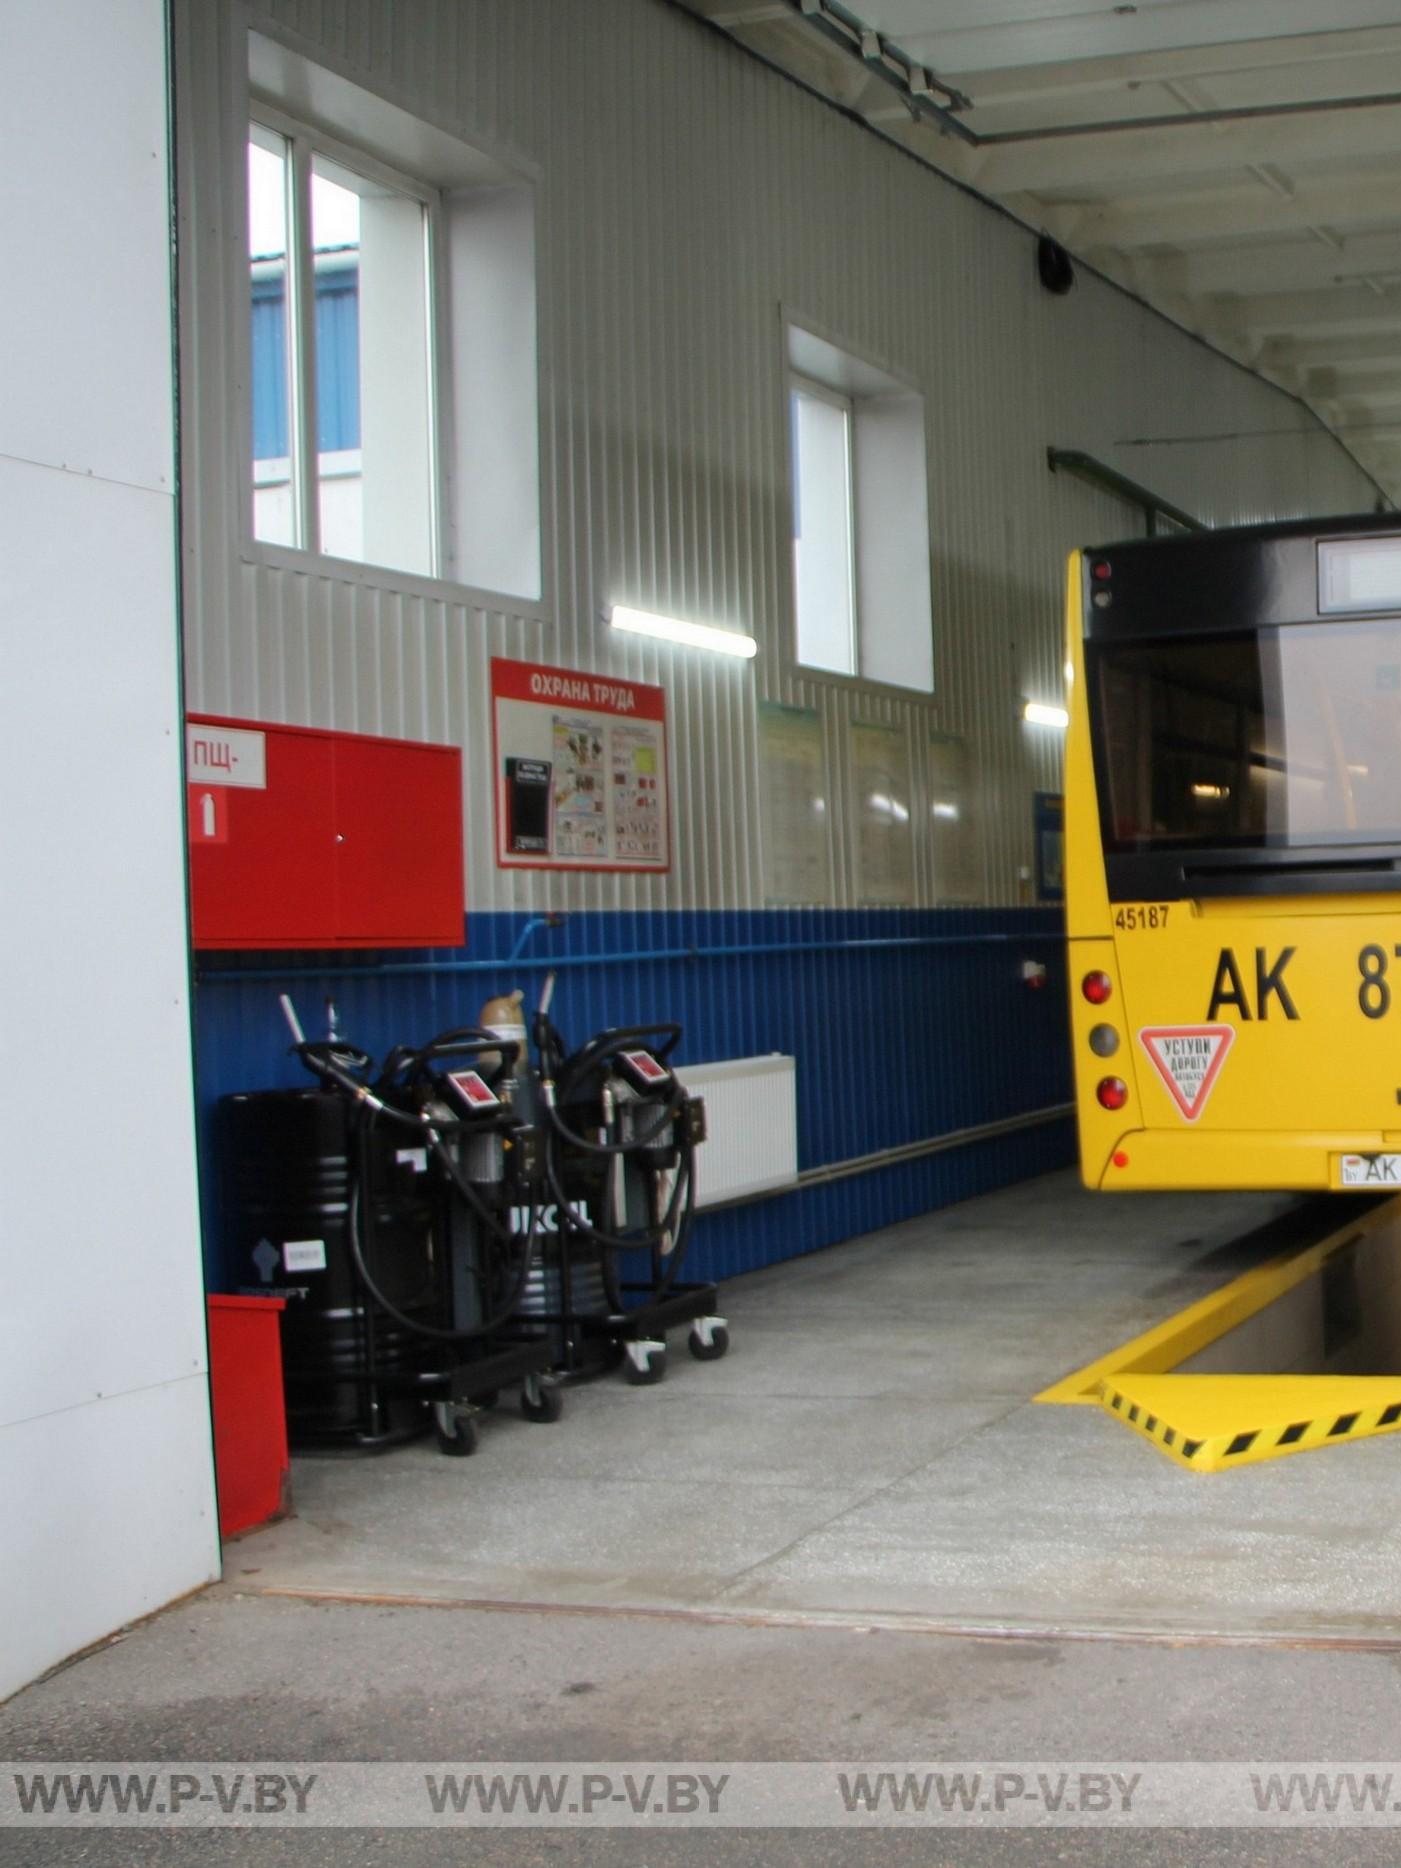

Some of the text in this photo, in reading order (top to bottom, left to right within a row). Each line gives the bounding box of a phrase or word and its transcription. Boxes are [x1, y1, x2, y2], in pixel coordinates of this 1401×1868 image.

[530, 673, 635, 710] ОХРАНА ТРУДА
[1115, 904, 1170, 931] 45187
[1206, 945, 1301, 1022] AK
[1164, 1037, 1211, 1056] УСТУПИ
[1171, 1055, 1208, 1073] ДОРОГУ
[1365, 1158, 1398, 1181] AK
